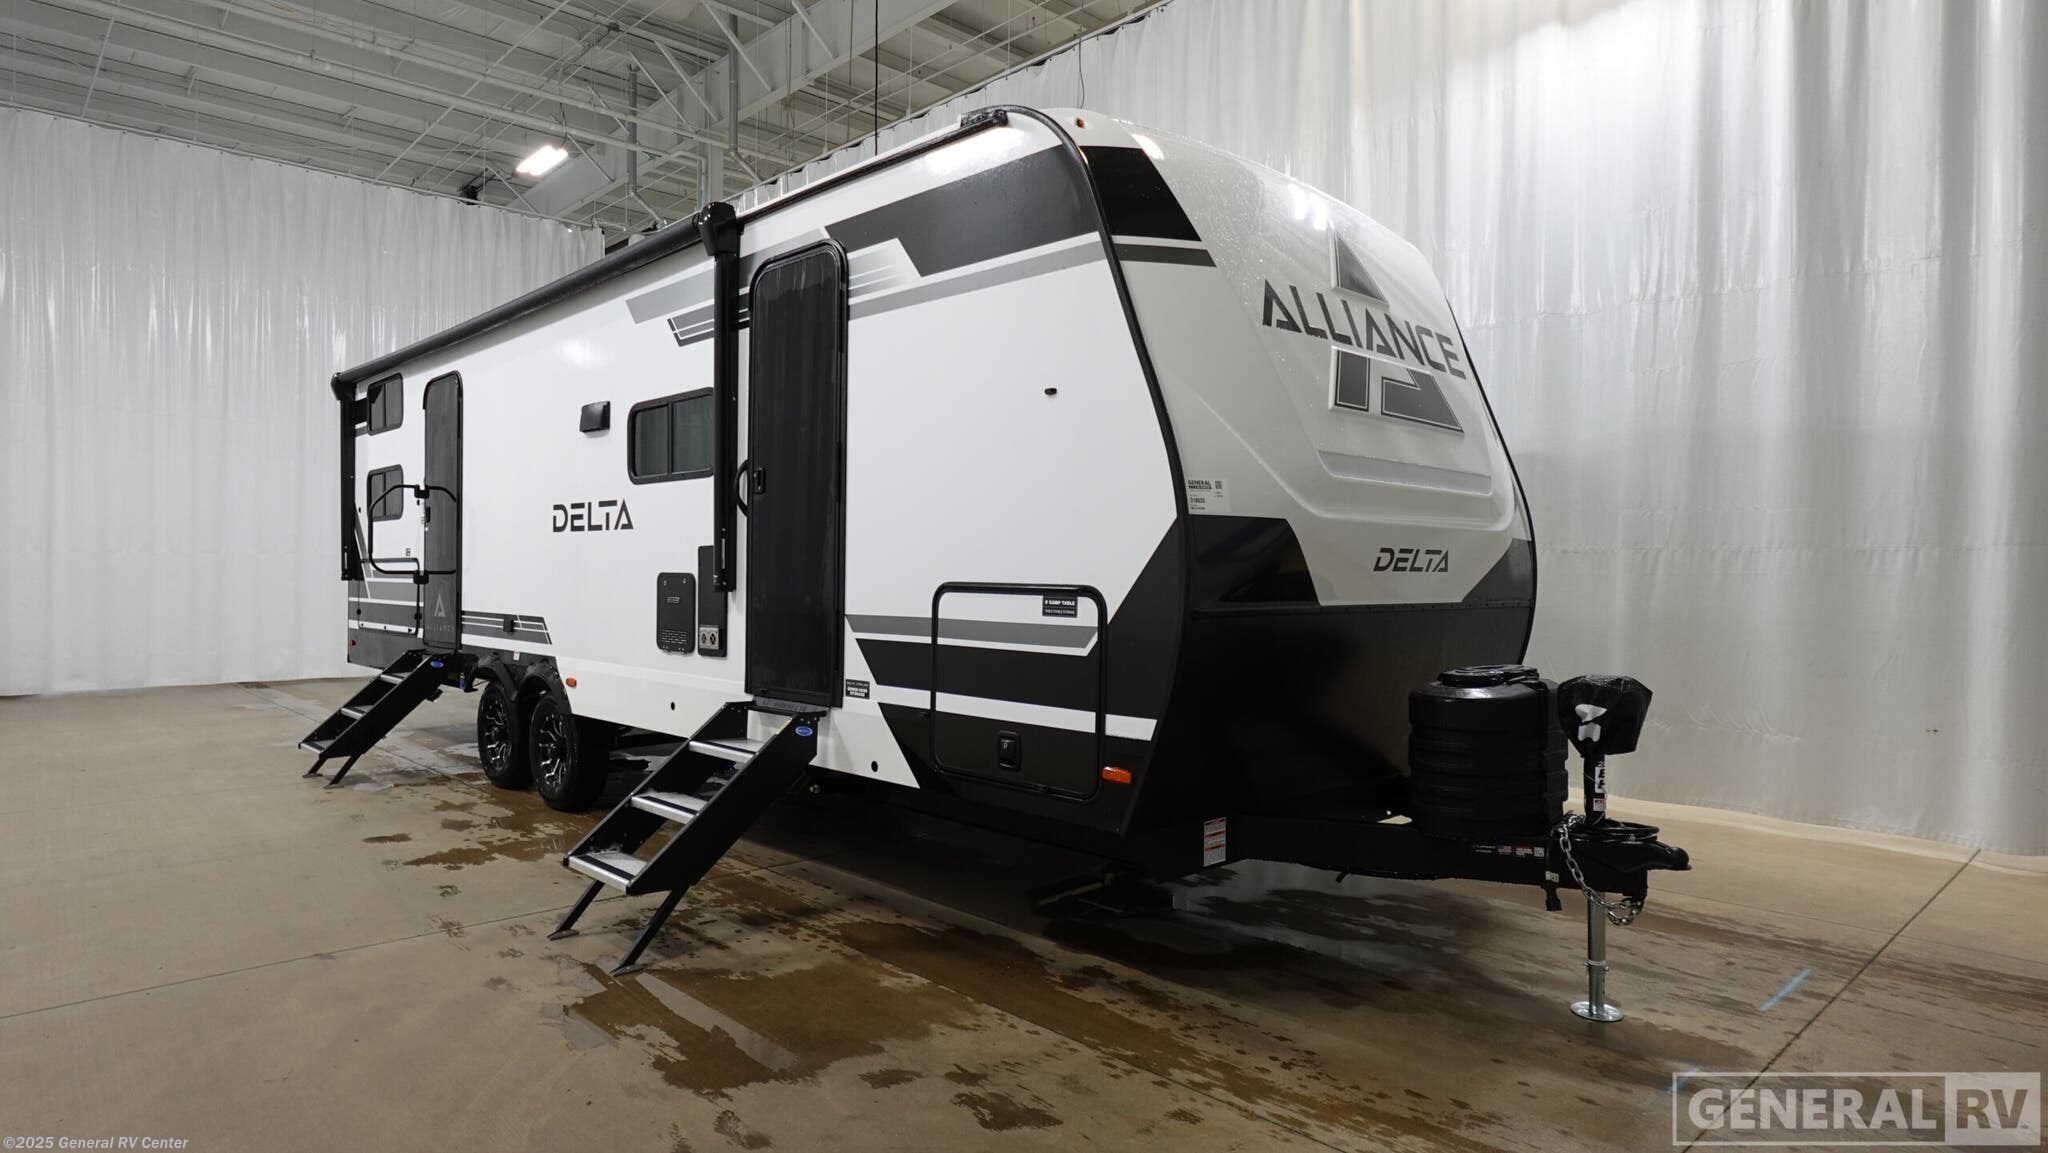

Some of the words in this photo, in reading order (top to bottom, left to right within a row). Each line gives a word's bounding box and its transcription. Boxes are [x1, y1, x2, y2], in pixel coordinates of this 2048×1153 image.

[1262, 278, 1466, 380] ALLIANCE
[553, 499, 634, 533] DELTA
[1373, 547, 1449, 573] DELTA
